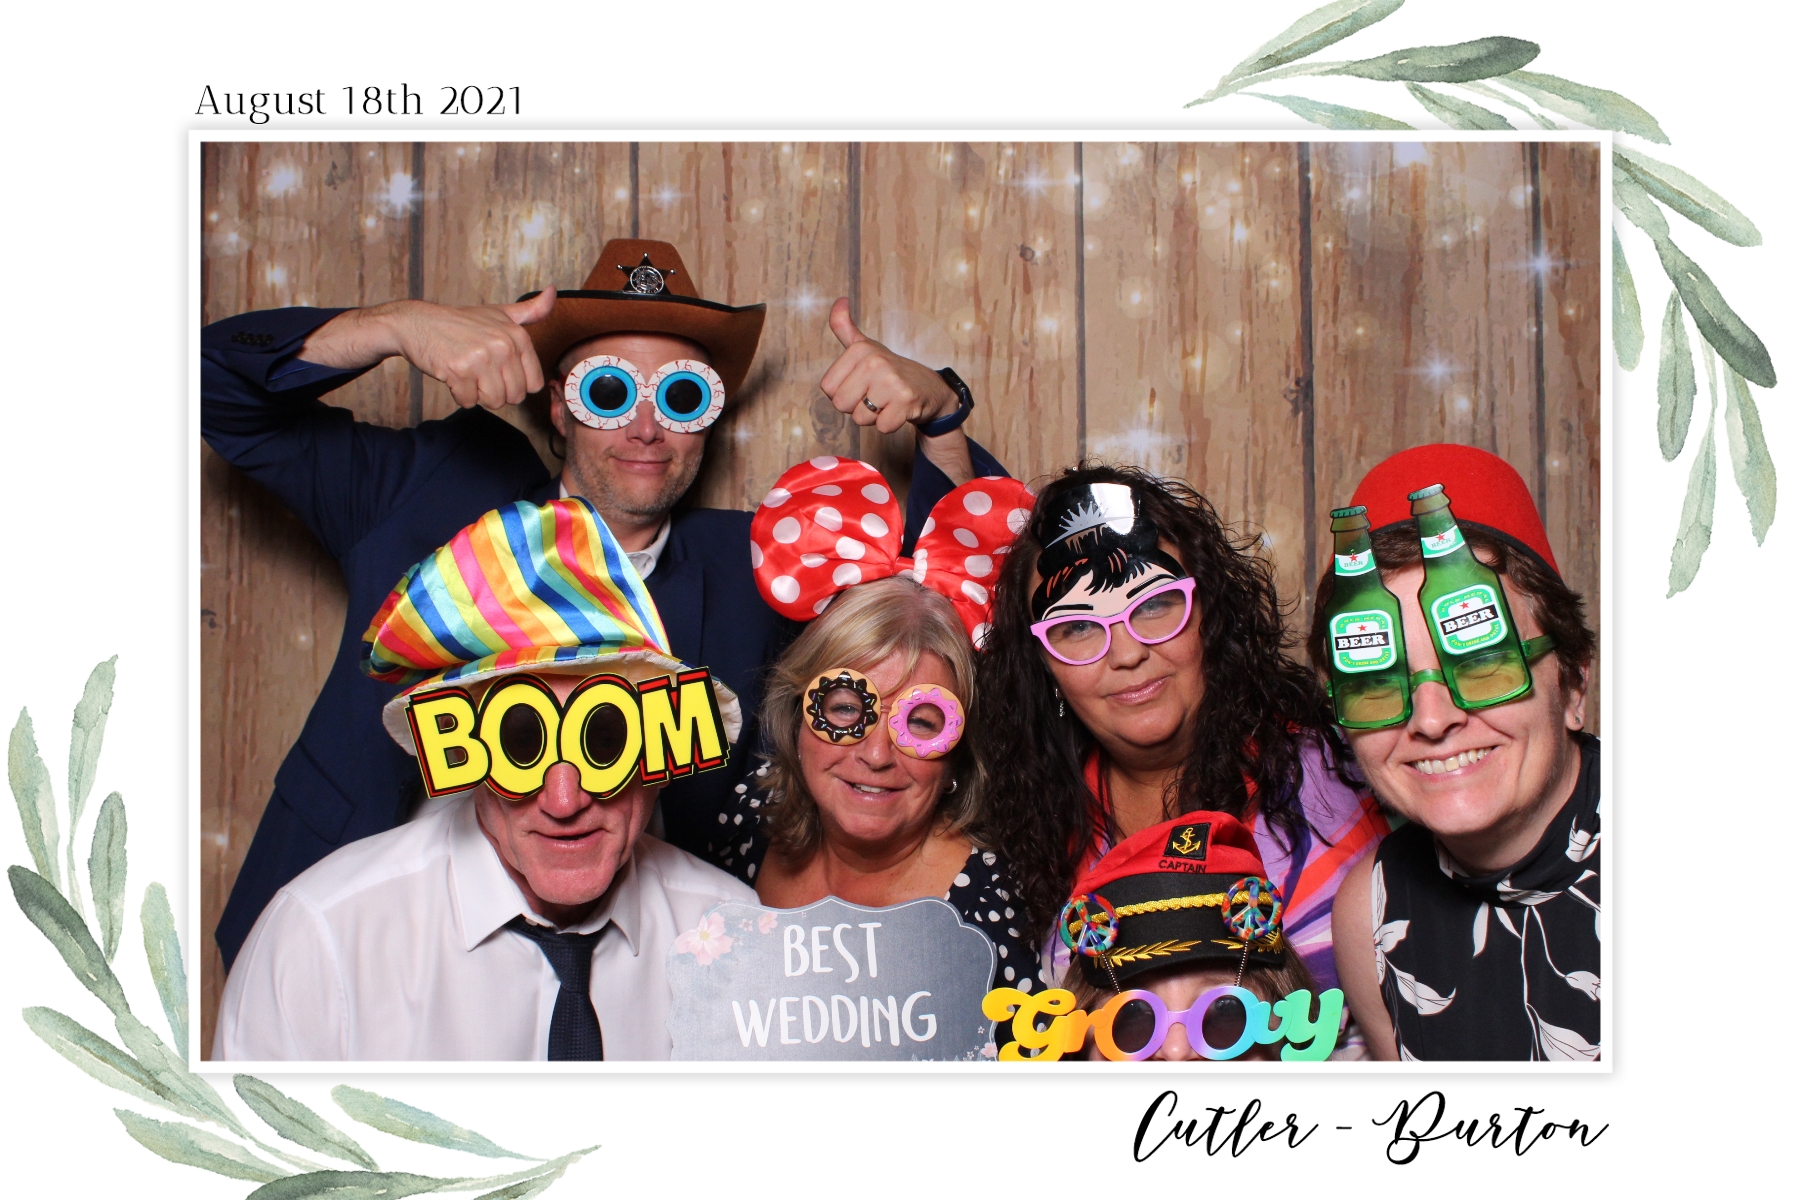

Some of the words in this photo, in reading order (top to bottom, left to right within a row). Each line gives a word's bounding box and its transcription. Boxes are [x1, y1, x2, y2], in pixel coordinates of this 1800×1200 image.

[1431, 537, 1451, 548] BEER
[1343, 560, 1364, 568] BEER
[1443, 608, 1494, 633] BEER
[1337, 634, 1386, 649] BEER
[405, 667, 729, 799] BOOM
[1158, 859, 1207, 874] CAPTAIN
[783, 922, 882, 984] BEST
[731, 990, 938, 1048] WEDDING
